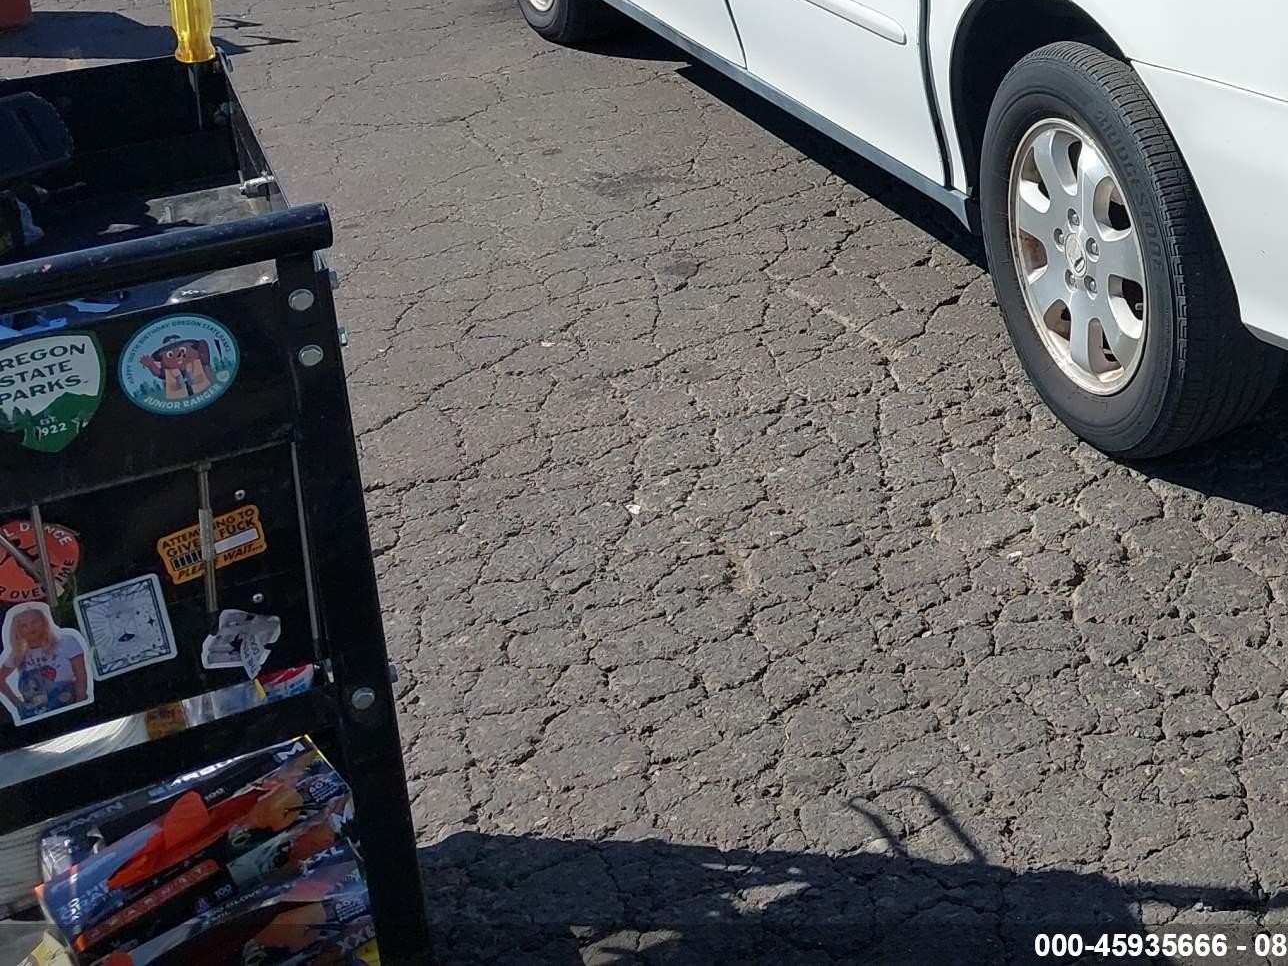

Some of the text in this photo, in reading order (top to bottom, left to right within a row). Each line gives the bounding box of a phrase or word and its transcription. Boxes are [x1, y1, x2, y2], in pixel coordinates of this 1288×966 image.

[0, 343, 85, 372] REGON
[143, 383, 220, 409] JUNIOR RANGER
[20, 523, 72, 546] DNCE
[162, 508, 255, 549] ATTEMING TO
[218, 517, 256, 538] FUCK
[176, 560, 218, 580] PLEA
